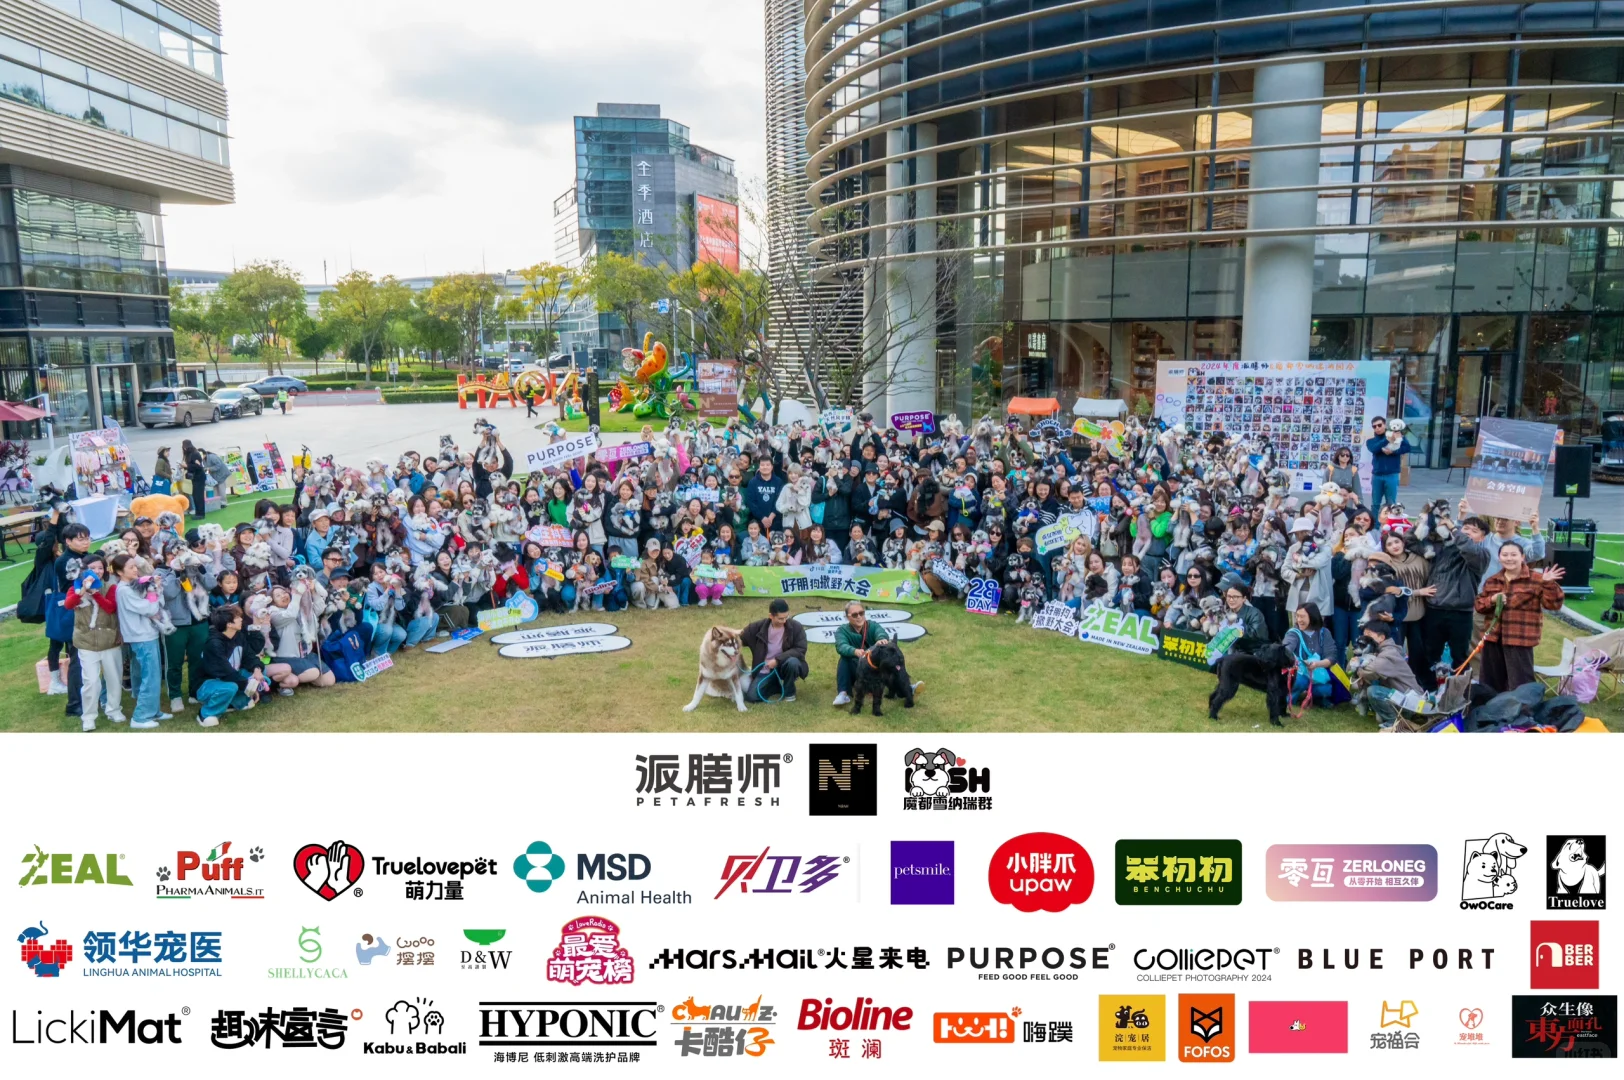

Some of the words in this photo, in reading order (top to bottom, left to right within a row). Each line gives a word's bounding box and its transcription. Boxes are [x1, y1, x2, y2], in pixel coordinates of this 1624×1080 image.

[636, 160, 654, 248] 全季酒店
[894, 414, 930, 422] PURPOSE
[527, 435, 593, 465] PURPOSE
[1486, 480, 1526, 495] 会务空间
[969, 578, 999, 599] 28
[967, 598, 992, 611] DAY
[1081, 603, 1157, 647] ZEAL
[1090, 635, 1105, 644] MADE
[1125, 642, 1150, 653] ZEALAND
